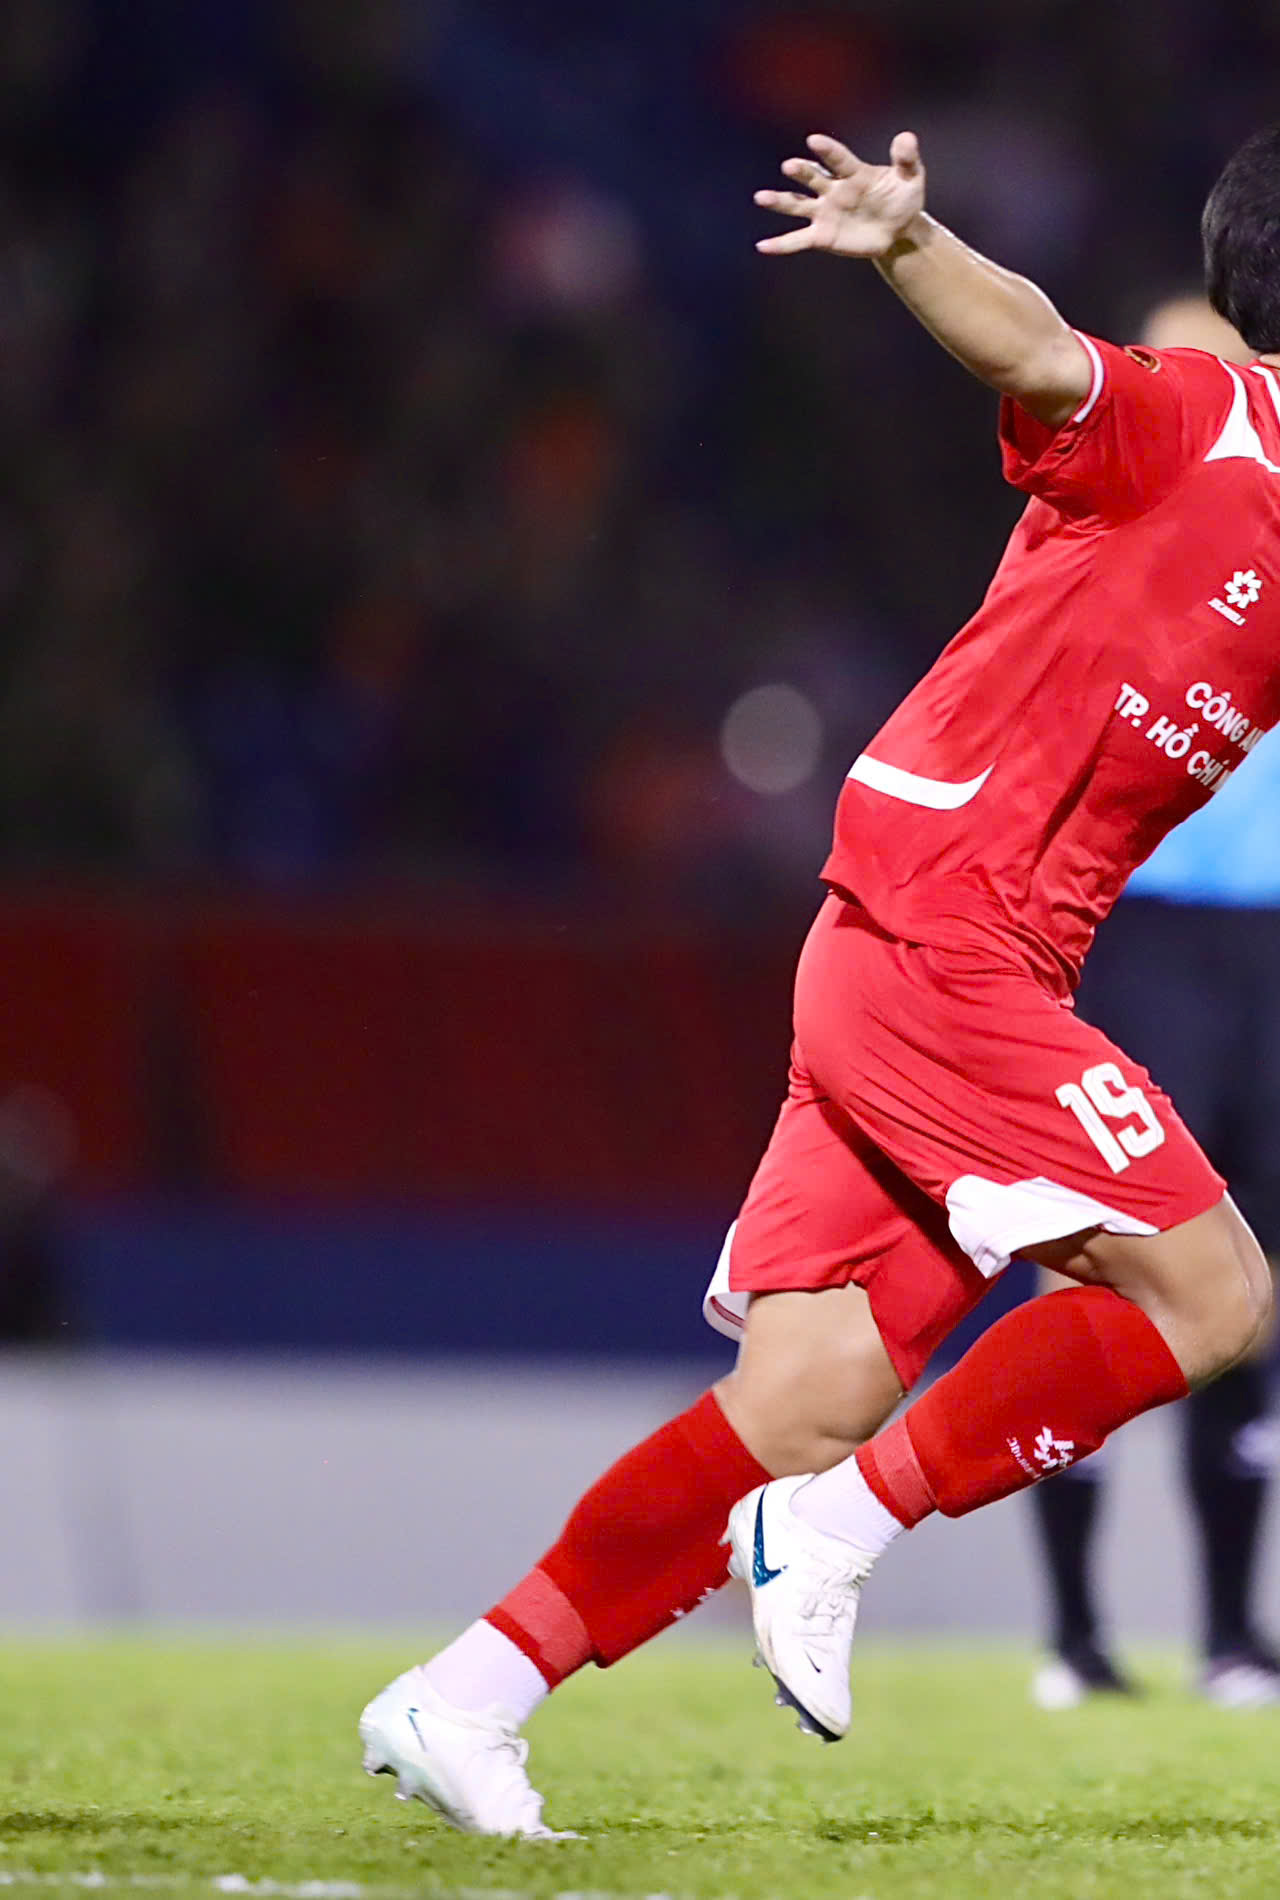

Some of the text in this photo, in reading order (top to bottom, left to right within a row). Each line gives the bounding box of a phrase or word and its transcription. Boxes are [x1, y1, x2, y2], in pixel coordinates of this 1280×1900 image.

[1114, 682, 1150, 727] TP.
[1145, 715, 1200, 758] HỒ
[1187, 750, 1230, 786] CHÍ
[1186, 682, 1249, 742] CÔNG
[1054, 1062, 1166, 1174] 19
